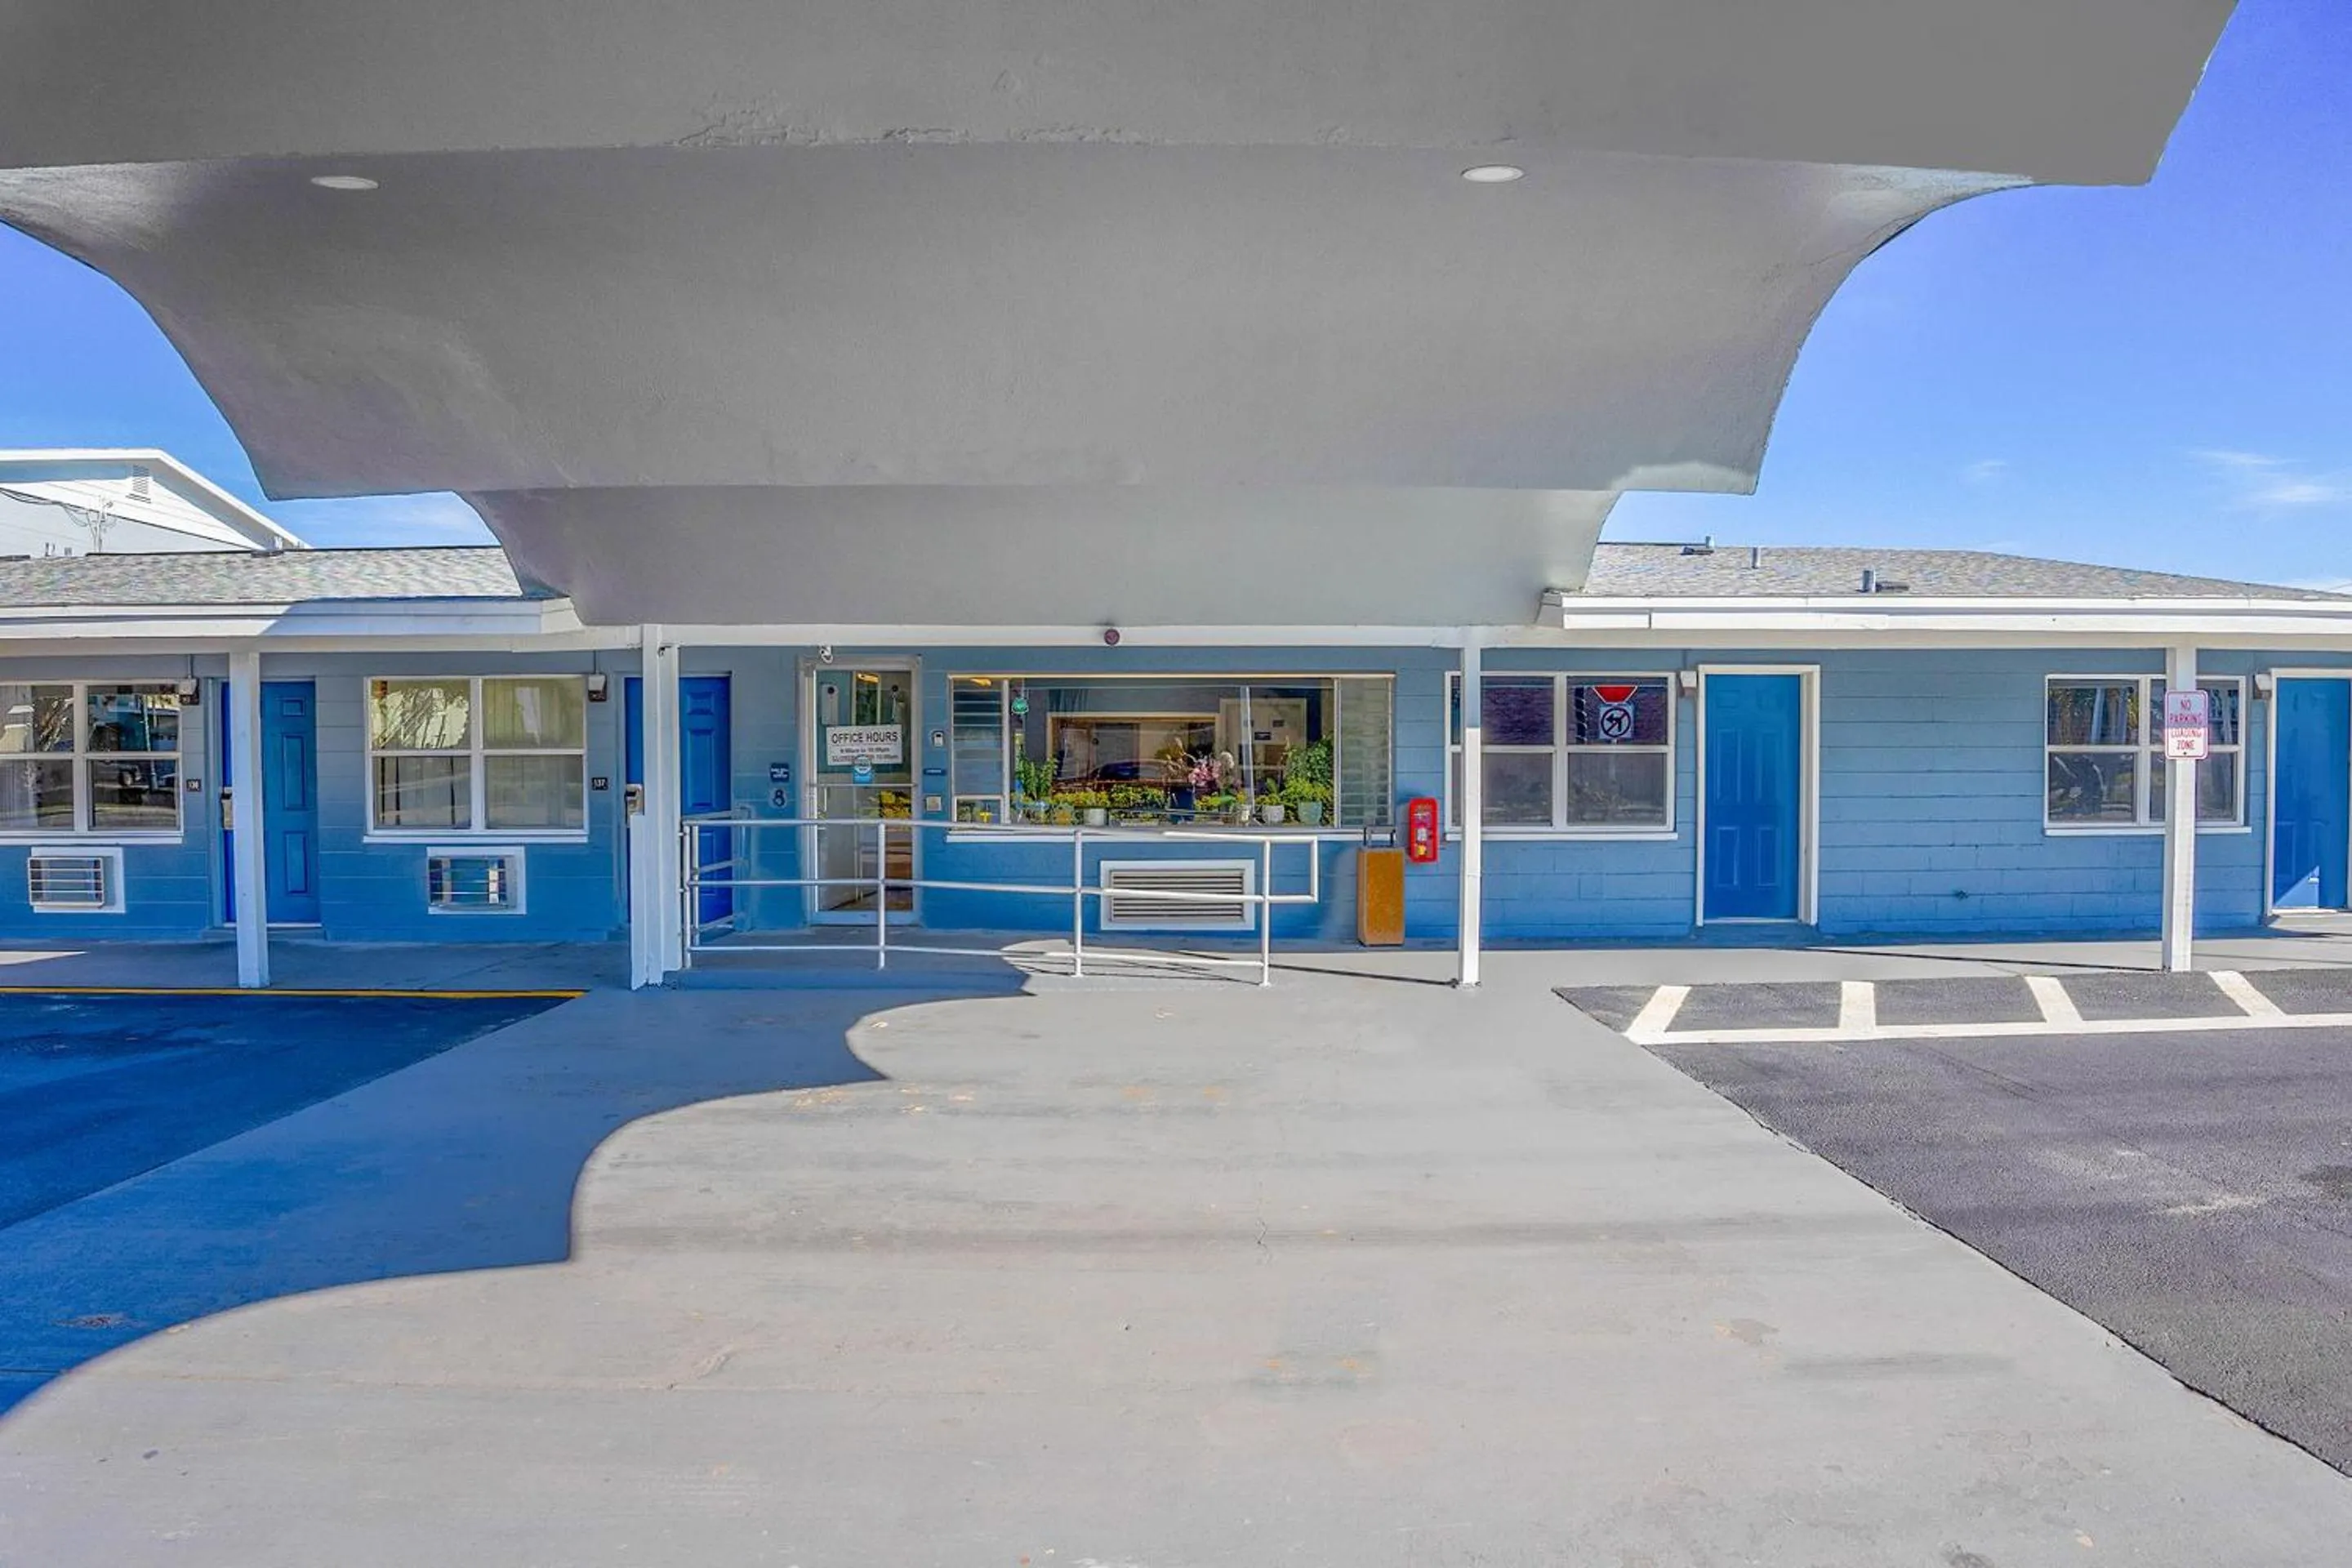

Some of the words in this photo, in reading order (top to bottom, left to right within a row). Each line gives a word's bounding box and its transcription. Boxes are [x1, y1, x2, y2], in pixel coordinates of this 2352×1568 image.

[2180, 699, 2192, 711] NO
[2169, 712, 2203, 725] PARKING
[831, 733, 864, 744] OFFICE
[866, 731, 898, 743] HOURS
[2171, 726, 2202, 738] LOADING
[2176, 739, 2195, 750] ZONE
